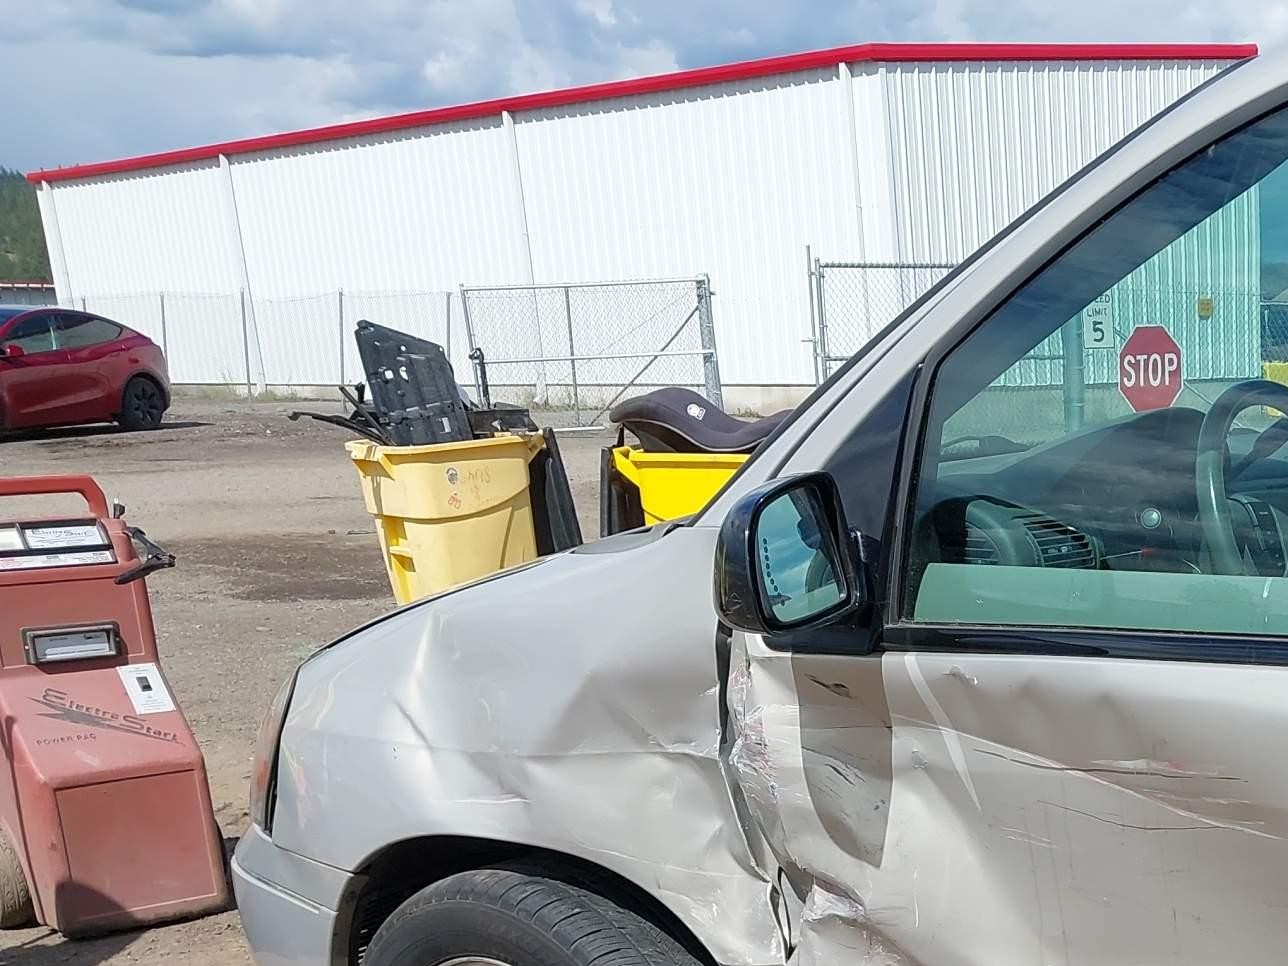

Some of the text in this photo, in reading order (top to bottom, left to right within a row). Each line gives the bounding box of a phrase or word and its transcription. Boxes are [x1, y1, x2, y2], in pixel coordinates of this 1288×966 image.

[1086, 307, 1108, 318] LIMIT
[1092, 320, 1105, 343] 5
[1123, 353, 1178, 388] STOP
[119, 714, 179, 741] Start
